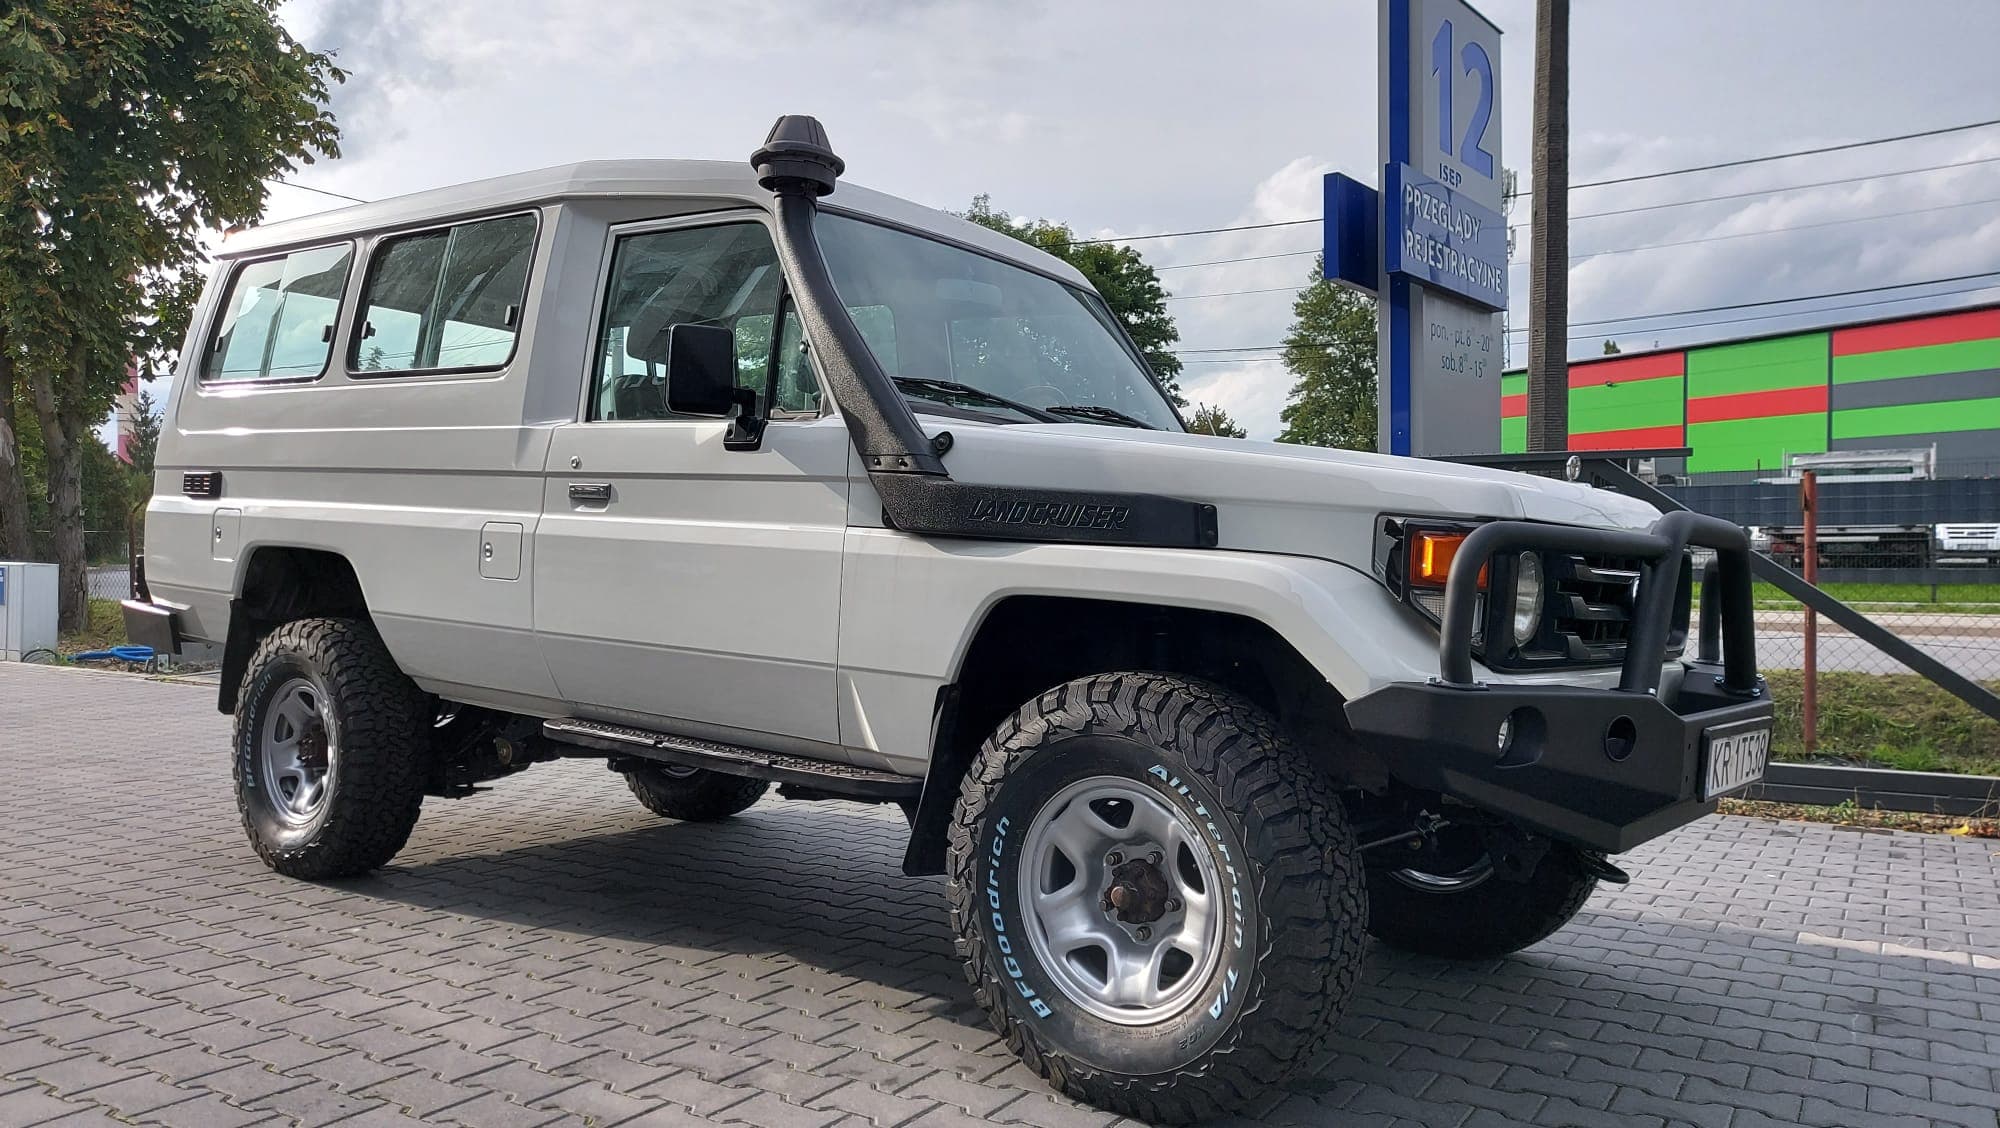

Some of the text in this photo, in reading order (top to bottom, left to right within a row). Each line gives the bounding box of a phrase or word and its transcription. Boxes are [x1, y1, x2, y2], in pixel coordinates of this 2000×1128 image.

[1431, 18, 1494, 181] 12
[1439, 162, 1462, 189] ISEP
[1405, 182, 1482, 245] PRZEGLĄDY
[1405, 227, 1503, 294] REJESTRACYJNE
[1430, 322, 1449, 342] pon.
[1441, 351, 1458, 373] sob.
[1711, 733, 1767, 790] KR 1T538
[986, 815, 1054, 1020] BFGoodrich
[1147, 763, 1243, 950] All-Terrain
[1208, 965, 1240, 1021] T/A
